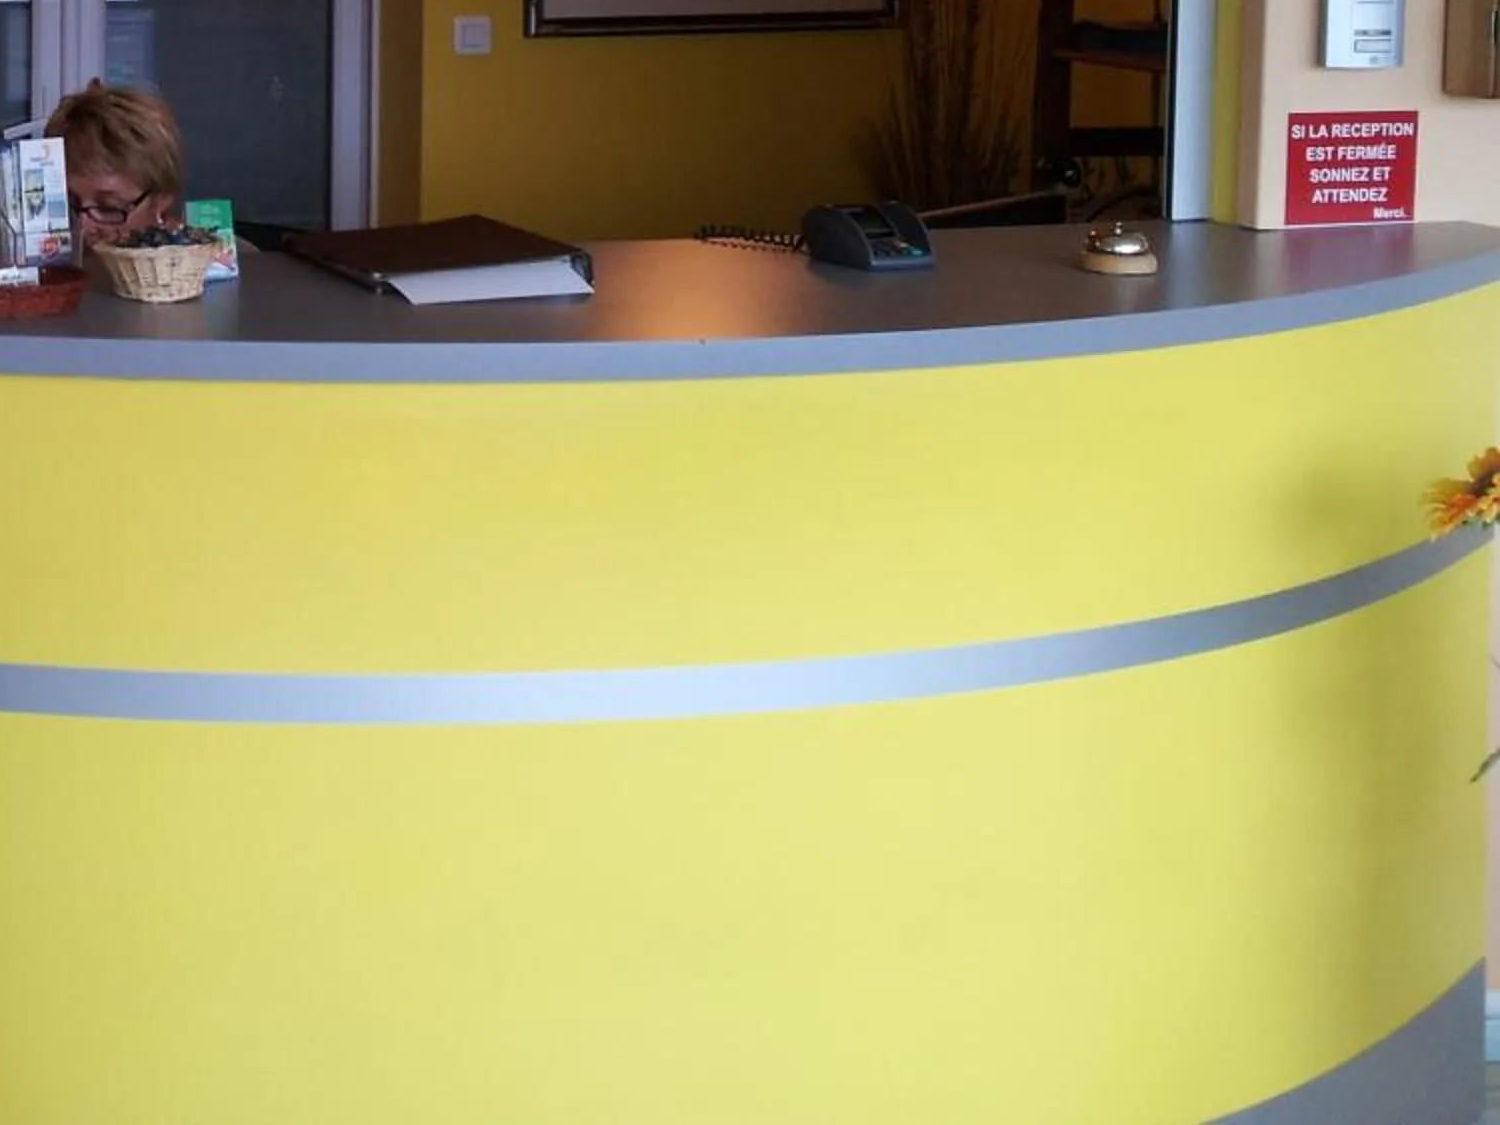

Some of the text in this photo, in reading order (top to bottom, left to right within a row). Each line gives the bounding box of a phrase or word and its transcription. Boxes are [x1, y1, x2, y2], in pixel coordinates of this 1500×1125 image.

[1291, 124, 1306, 140] SI
[1309, 124, 1329, 138] LA
[1306, 146, 1336, 162] EST
[1310, 166, 1392, 183] SONNEZ ET
[1312, 186, 1389, 204] ATTENDEZ
